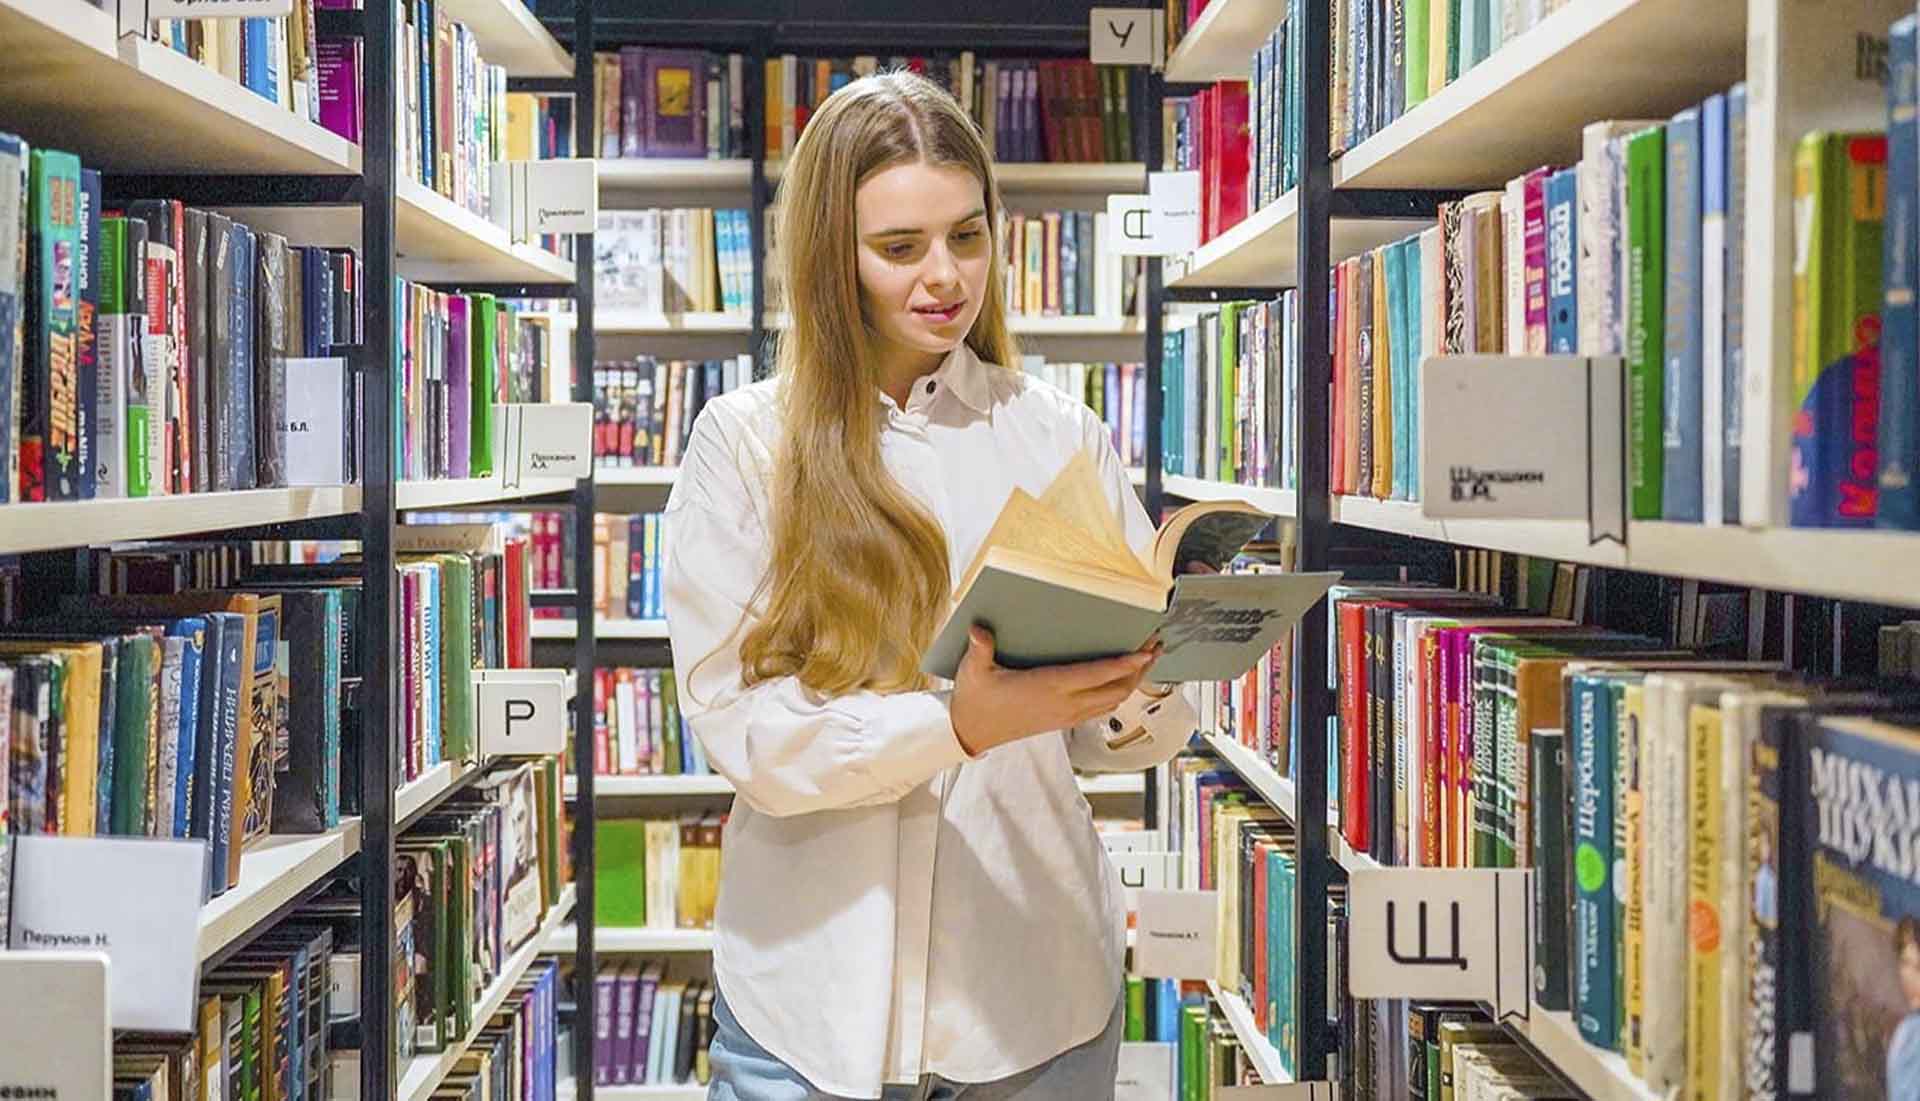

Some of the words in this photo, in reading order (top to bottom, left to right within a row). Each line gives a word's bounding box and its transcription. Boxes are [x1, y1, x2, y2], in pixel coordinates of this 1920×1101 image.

[1108, 21, 1135, 48] У
[1449, 466, 1545, 486] Шукшин
[225, 687, 238, 783] ПЕРМИТИН
[505, 699, 536, 736] Р
[1578, 690, 1600, 838] Щербакова
[23, 929, 91, 946] Перумов
[1386, 901, 1468, 971] Щ
